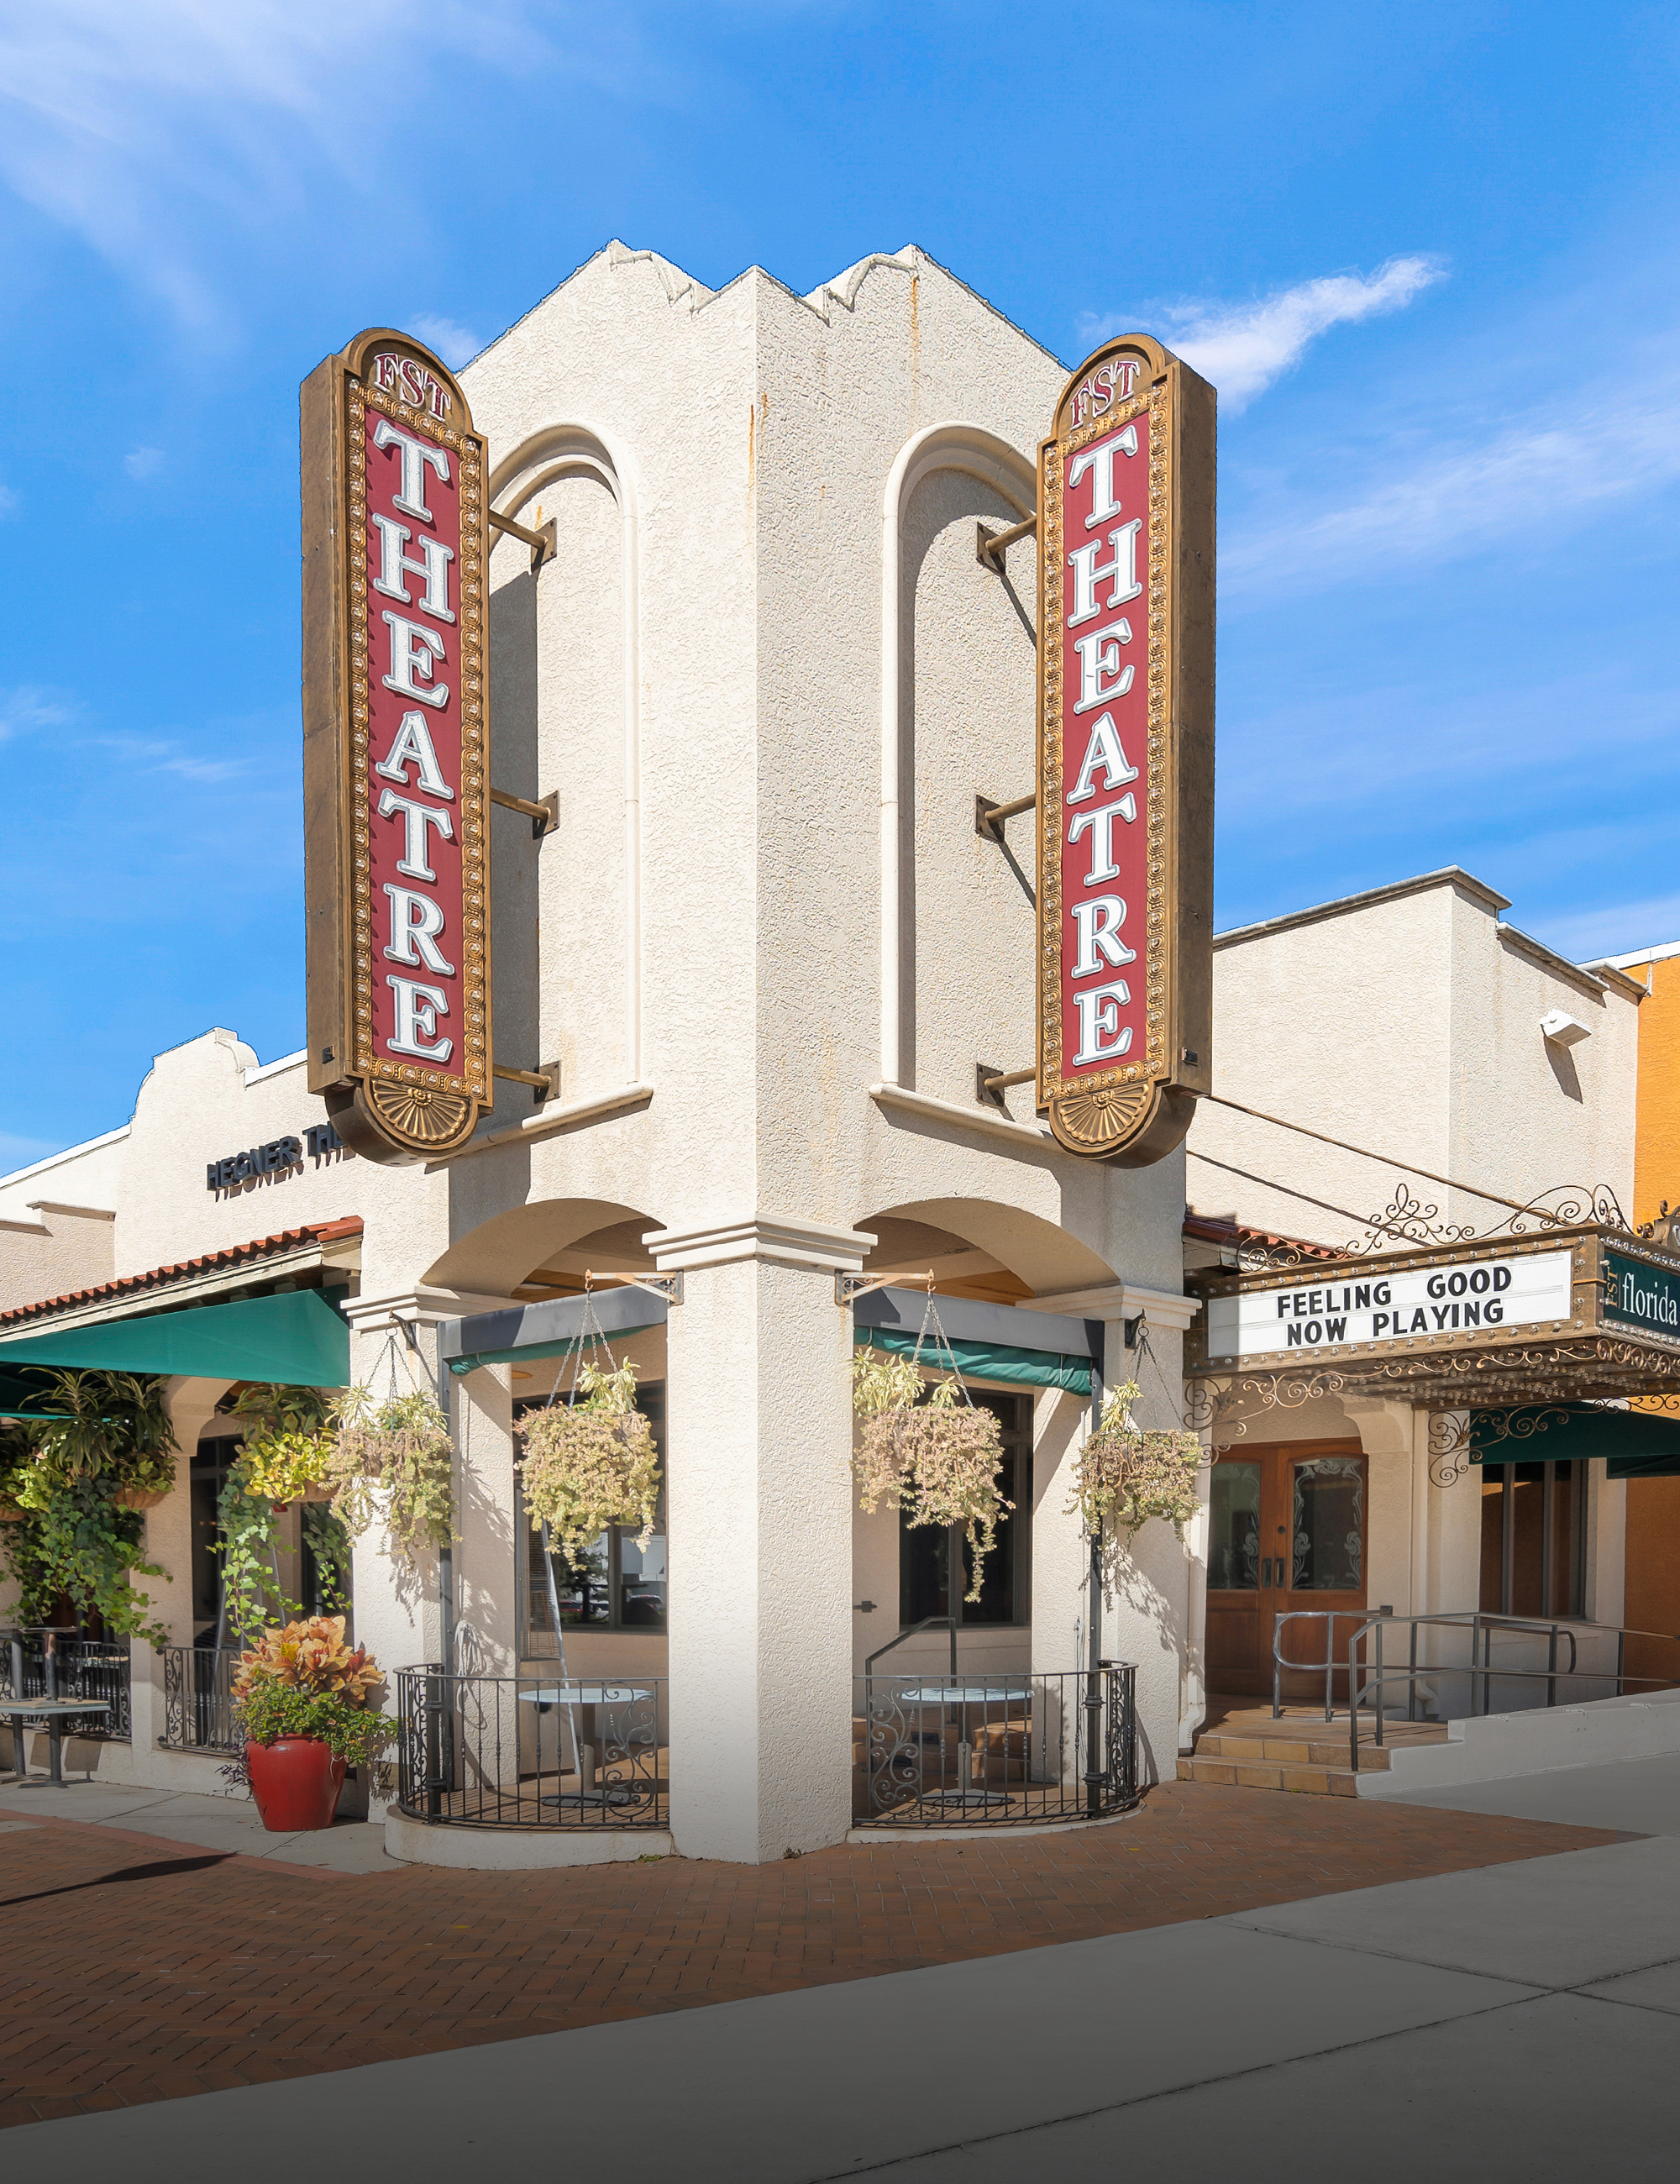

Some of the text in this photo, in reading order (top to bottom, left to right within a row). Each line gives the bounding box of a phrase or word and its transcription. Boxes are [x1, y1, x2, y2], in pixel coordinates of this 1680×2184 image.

[373, 352, 451, 421] FST
[1069, 360, 1141, 429] FST
[372, 419, 456, 1063] THEATRE
[1067, 424, 1143, 1068] THEATRE
[207, 1135, 303, 1191] HEGNER
[1277, 1266, 1512, 1318] FEELING GOOD
[1287, 1298, 1504, 1347] NOW PLAYING
[1623, 1273, 1678, 1326] florida
